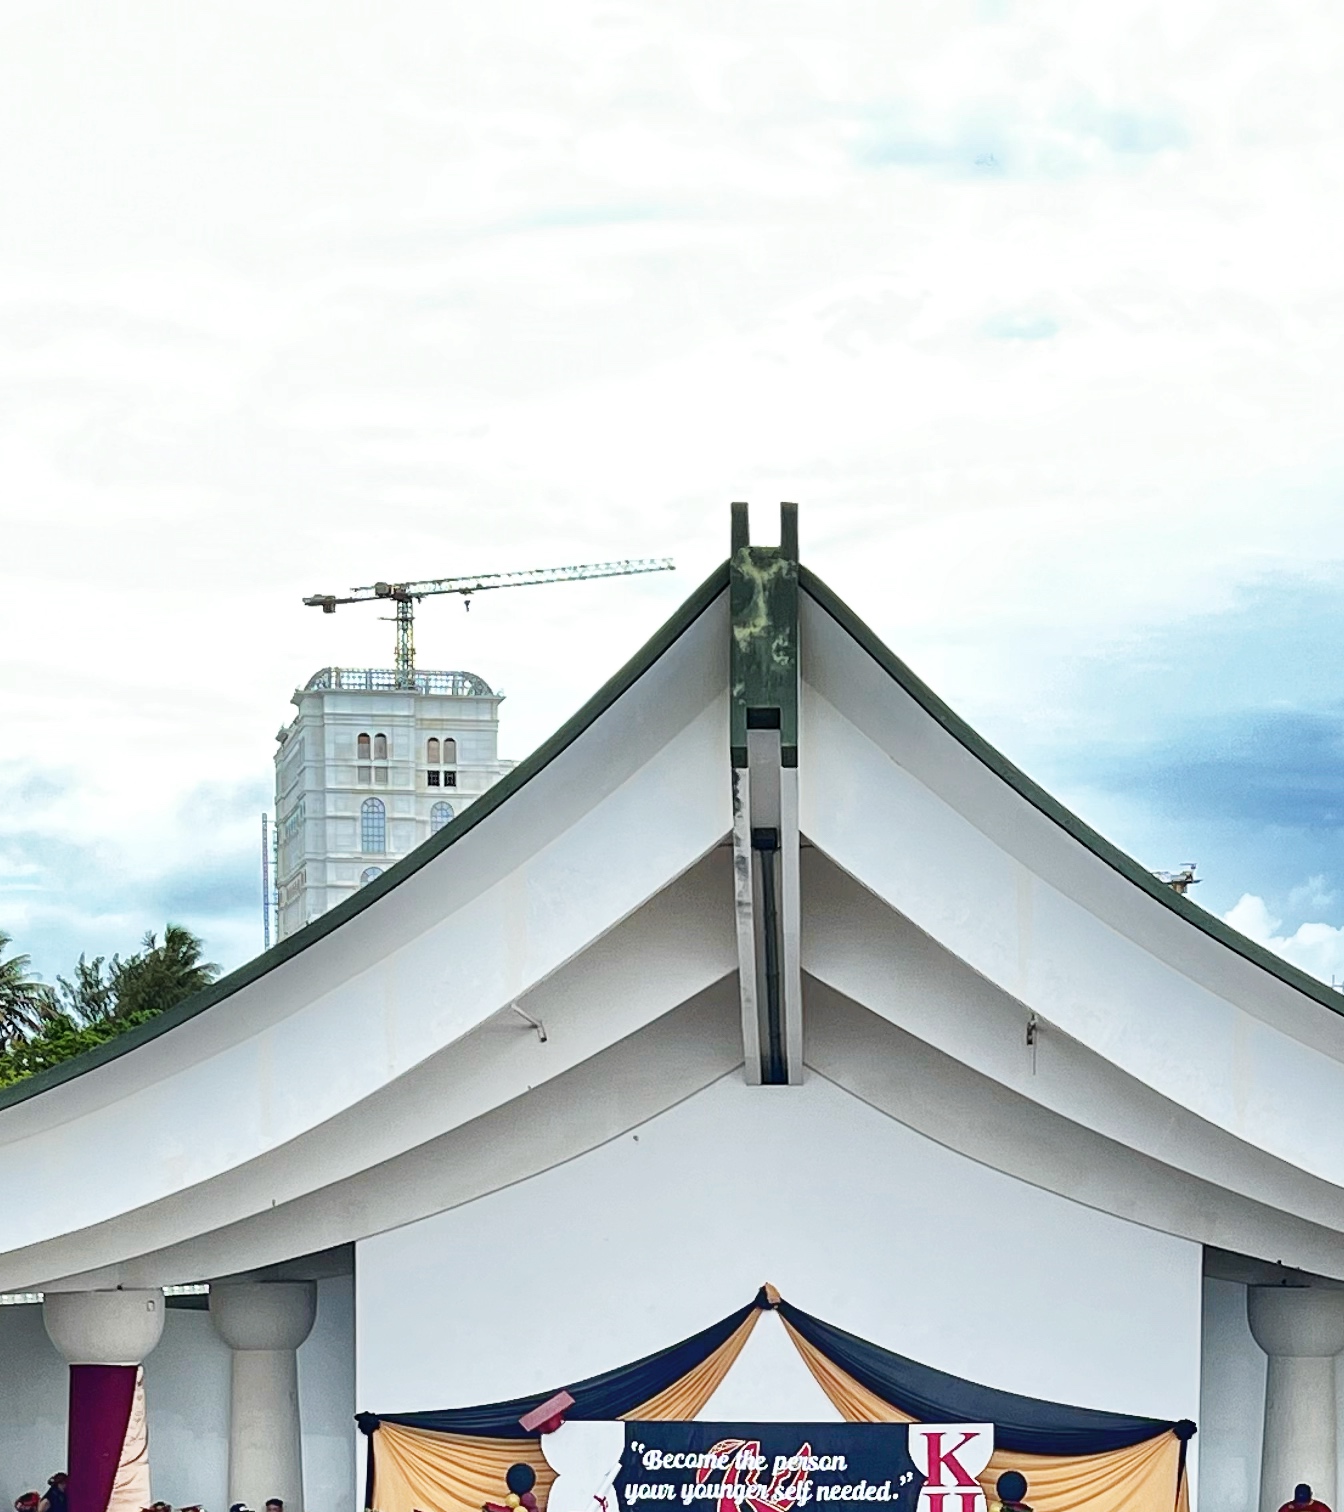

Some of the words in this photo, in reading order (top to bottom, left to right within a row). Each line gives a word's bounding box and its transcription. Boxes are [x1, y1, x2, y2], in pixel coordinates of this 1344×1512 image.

[734, 1448, 769, 1472] the
[772, 1452, 848, 1476] person
[624, 1483, 675, 1506] your
[681, 1480, 767, 1506] younger
[773, 1479, 814, 1507] self
